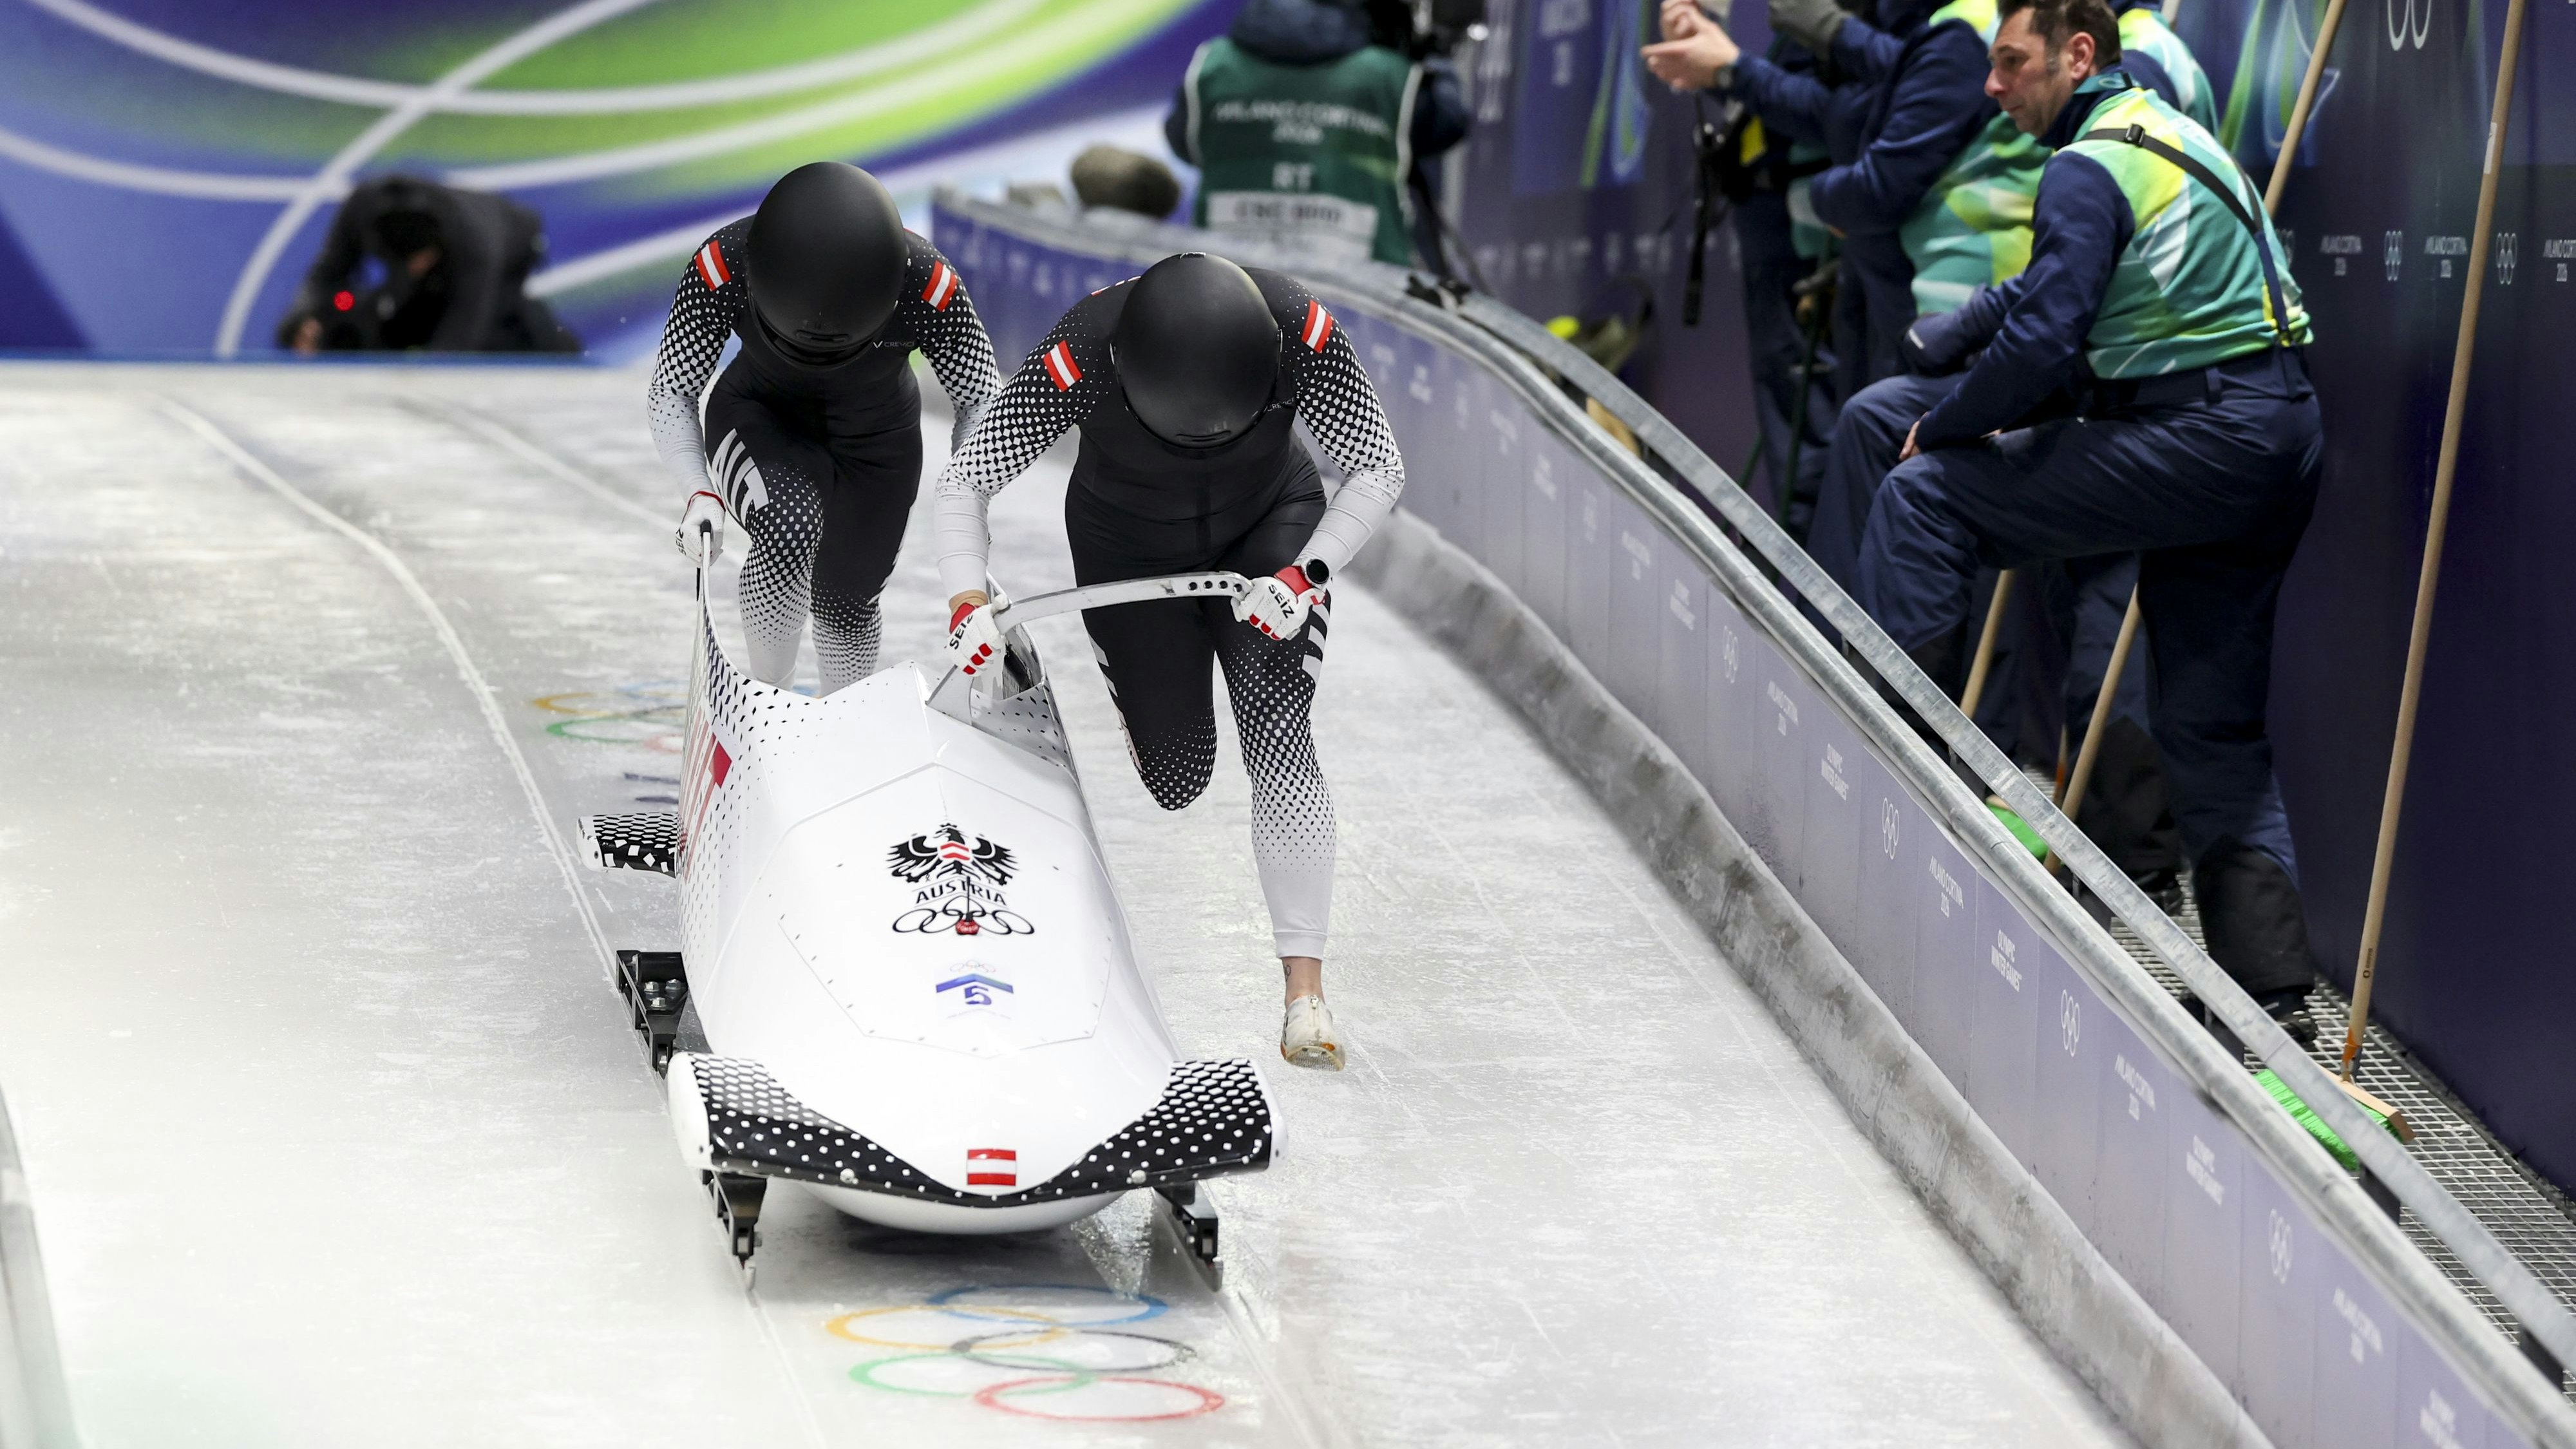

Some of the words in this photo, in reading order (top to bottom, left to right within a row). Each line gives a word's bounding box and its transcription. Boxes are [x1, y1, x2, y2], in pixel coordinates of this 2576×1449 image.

[1268, 584, 1295, 619] SEIZ
[916, 879, 1007, 906] AUSTRIA
[1929, 855, 1945, 889] MILANO
[1946, 872, 1964, 909] CORTINA
[1991, 945, 2007, 978] WINTER
[1998, 929, 2016, 963] OLYMPIC
[965, 985, 992, 1005] 5
